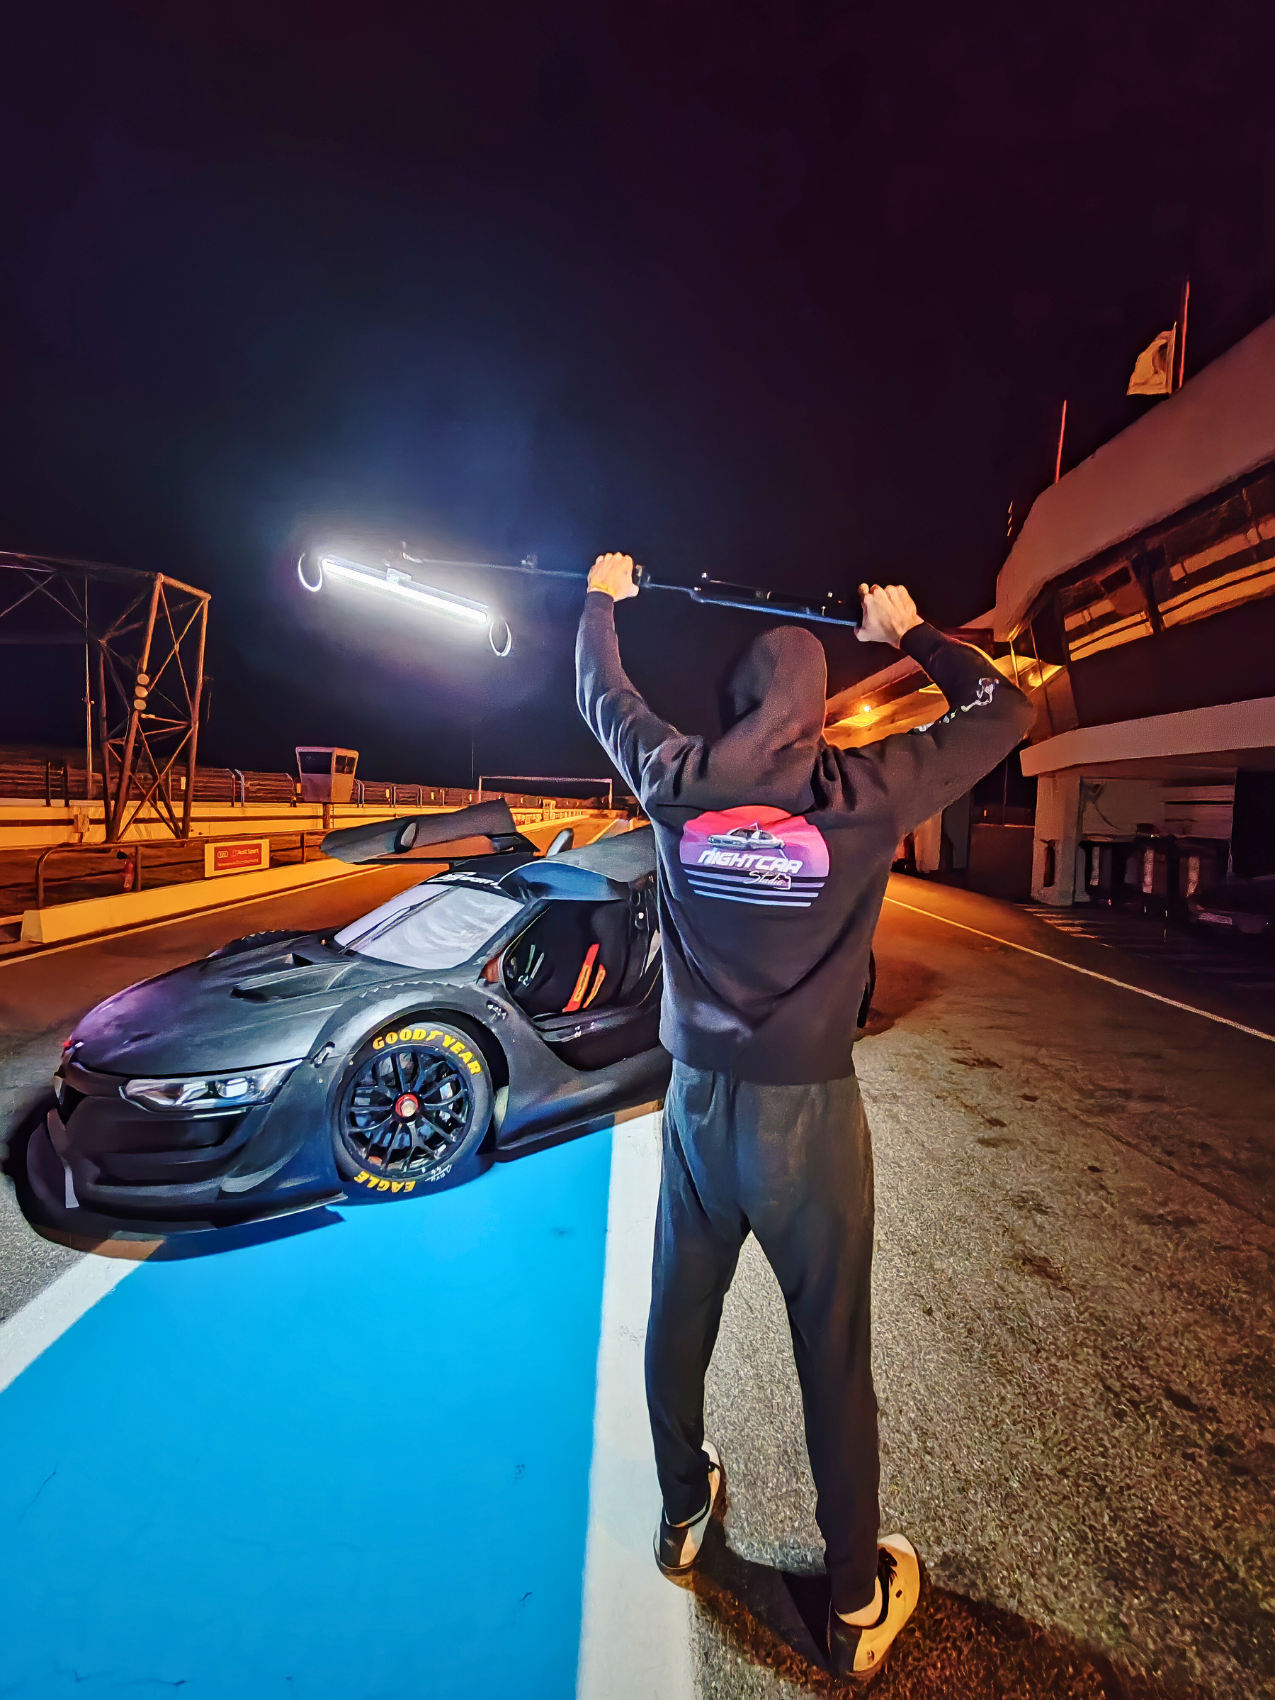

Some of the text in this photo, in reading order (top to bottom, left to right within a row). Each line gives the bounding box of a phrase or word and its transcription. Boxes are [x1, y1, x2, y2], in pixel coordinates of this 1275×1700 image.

[698, 849, 803, 873] NIGHTCAR
[372, 1028, 483, 1075] GOODYEAR
[353, 1170, 416, 1193] EAGLE
